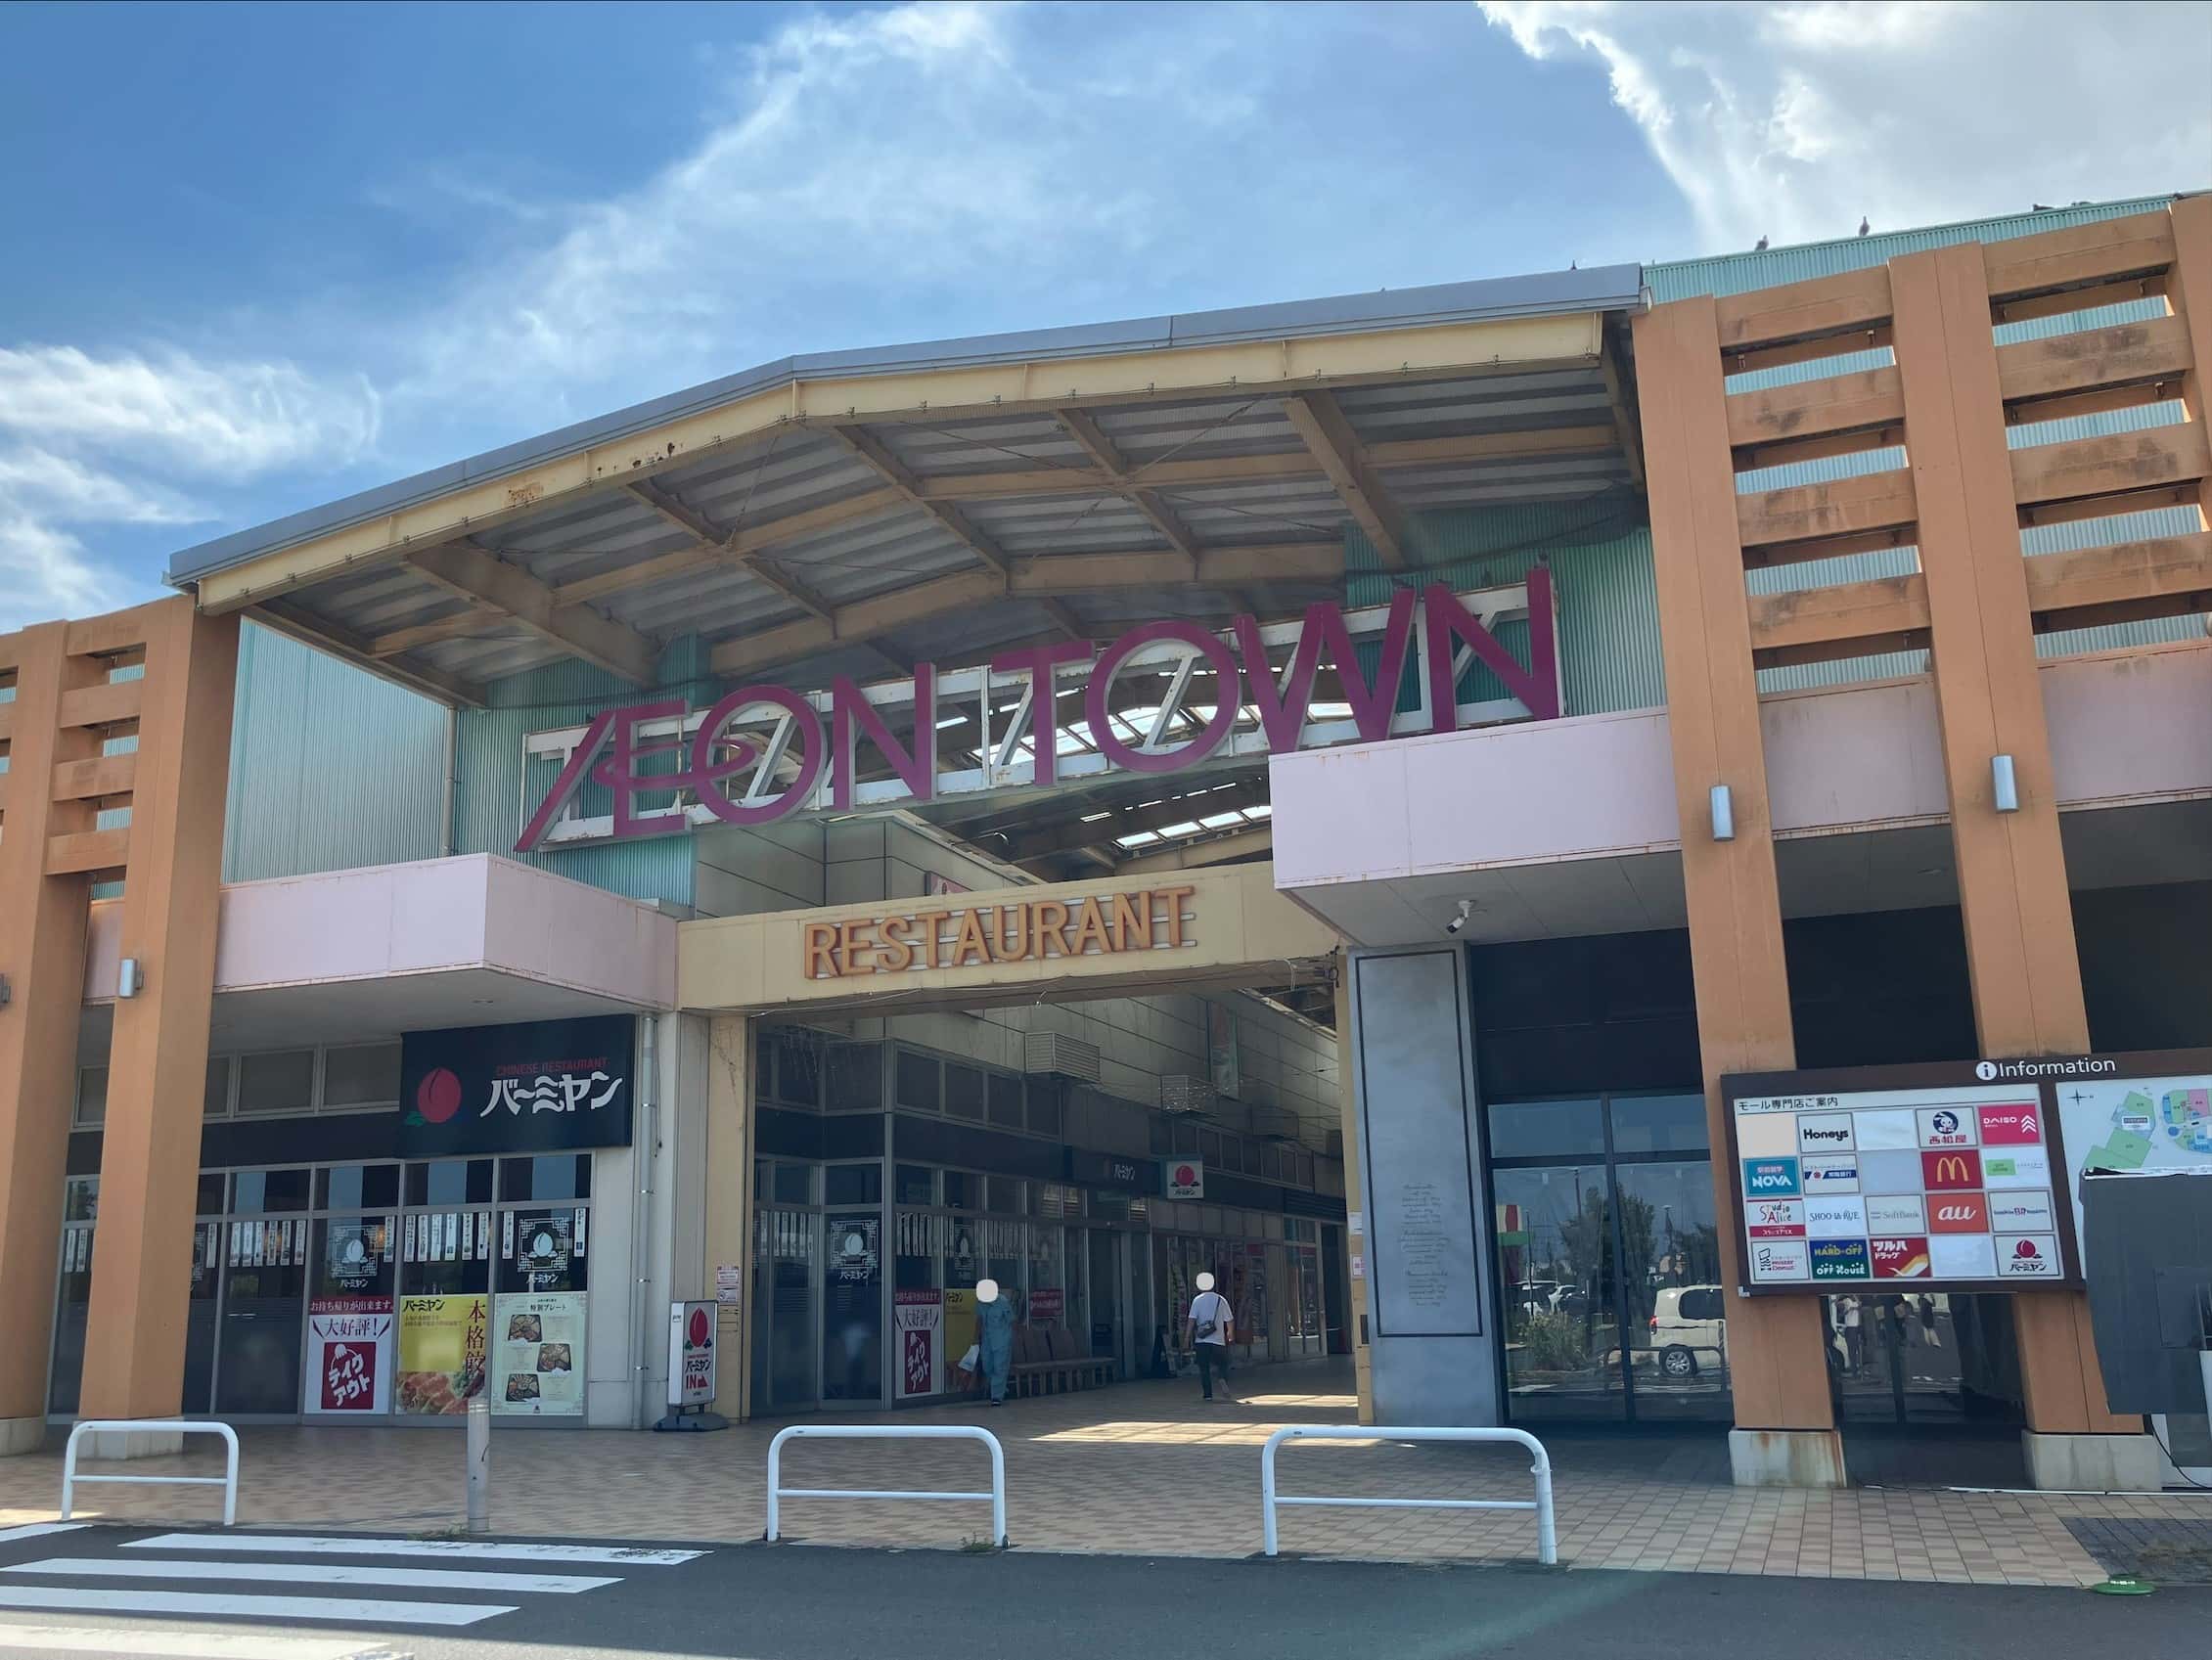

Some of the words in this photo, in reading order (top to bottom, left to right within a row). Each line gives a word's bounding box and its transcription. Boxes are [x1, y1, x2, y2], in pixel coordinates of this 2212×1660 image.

[991, 568, 1559, 785] TOWN
[805, 885, 1196, 979] RESTAURANT
[1999, 1056, 2117, 1079] Information
[479, 1070, 623, 1118] バーミヤン
[1738, 1097, 1838, 1111] モール専門店ご案内
[1983, 1116, 2017, 1125] DAISO
[1803, 1128, 1849, 1142] Honeys
[1752, 1175, 1792, 1189] NOVA
[1938, 1205, 1977, 1221] au
[1873, 1240, 1908, 1252] ツルハ
[403, 1299, 445, 1312] バーミヤン
